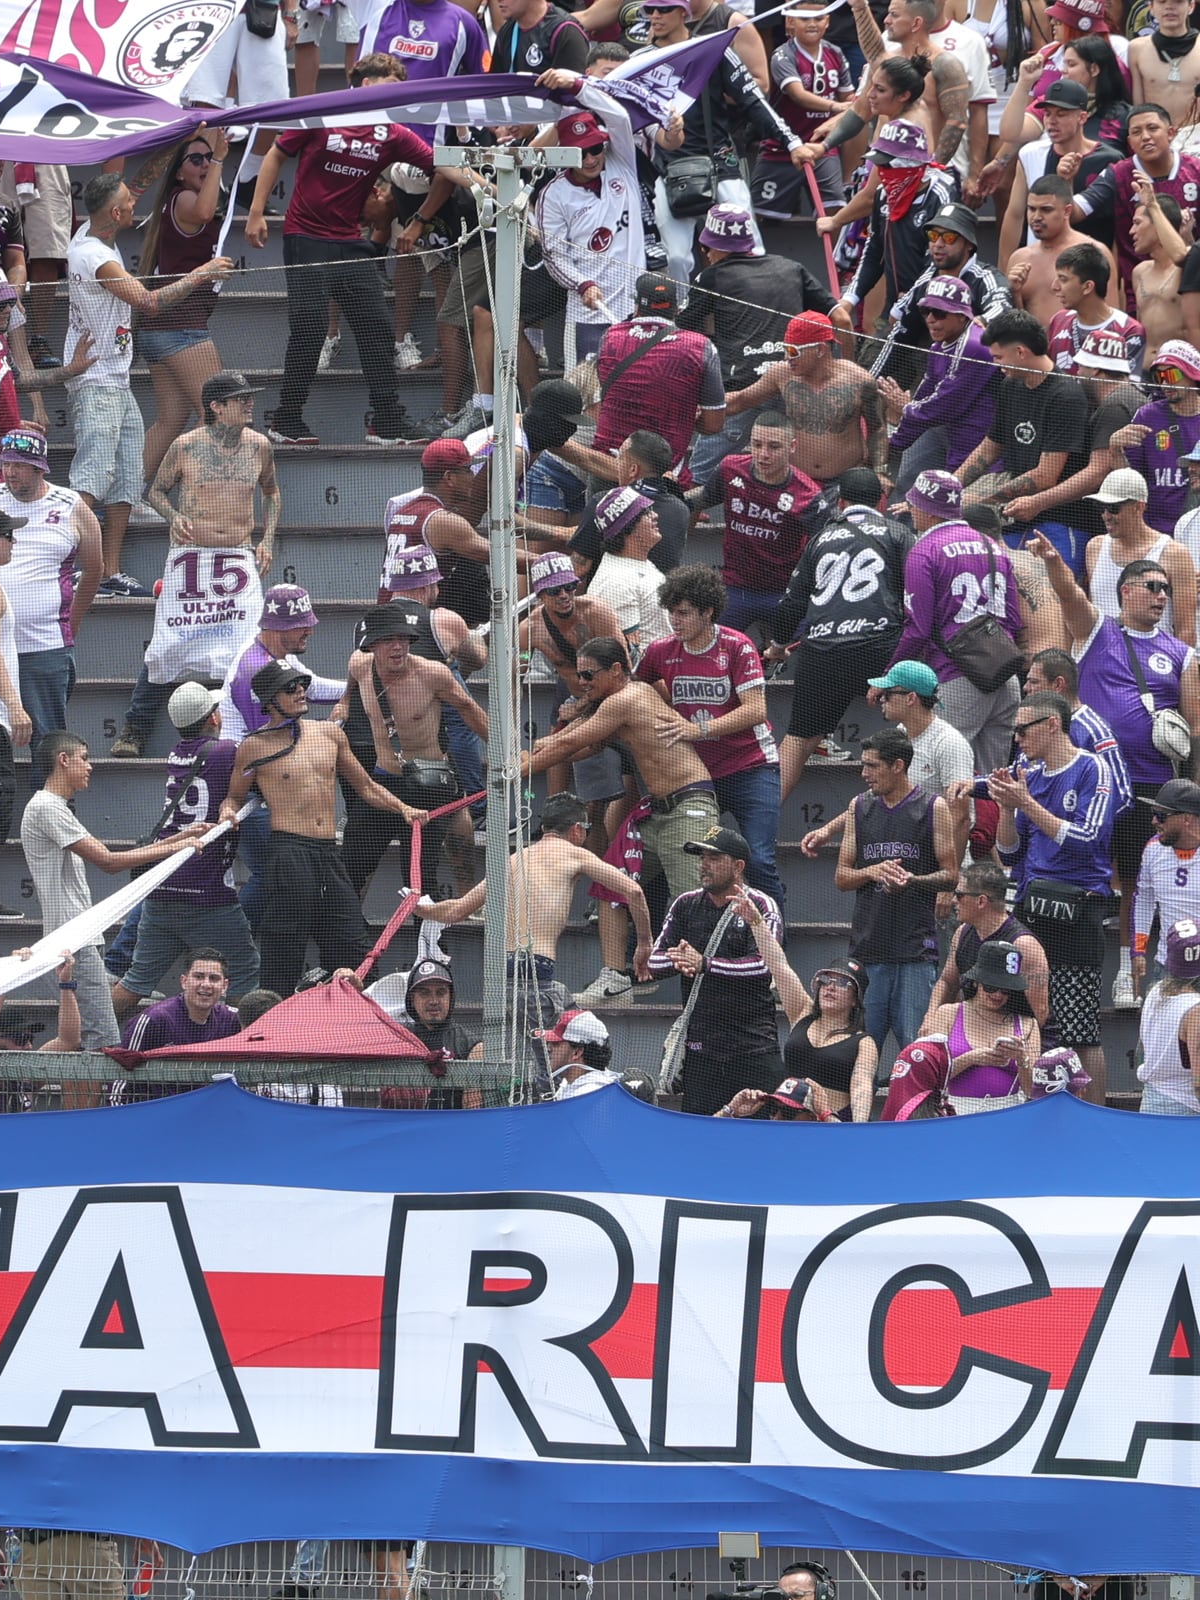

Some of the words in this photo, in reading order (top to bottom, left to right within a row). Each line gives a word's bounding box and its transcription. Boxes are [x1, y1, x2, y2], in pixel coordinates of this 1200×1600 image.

[395, 41, 434, 58] BIMBO
[944, 38, 956, 51] S
[828, 71, 839, 89] S
[374, 125, 387, 141] S
[350, 140, 382, 155] BAC
[324, 162, 370, 178] LIBERTY
[762, 182, 777, 200] S
[1184, 183, 1197, 201] S
[927, 280, 957, 302] GUI-2
[55, 411, 68, 427] 3
[325, 487, 338, 505] 6
[748, 502, 784, 524] BAC
[730, 520, 780, 541] LIBERTY
[173, 552, 250, 600] 15
[284, 566, 296, 583] 6
[810, 548, 886, 606] 98
[183, 599, 236, 614] ULTRA
[167, 615, 191, 628] CON
[194, 609, 246, 625] AGUANTE
[807, 623, 835, 639] LOS
[837, 617, 889, 637] GUI-2
[673, 680, 729, 704] BIMBO
[103, 720, 116, 738] 5
[839, 723, 860, 743] 12
[801, 804, 825, 823] 12
[1173, 867, 1188, 886] S
[21, 879, 34, 897] 5
[1030, 895, 1077, 921] VLTN
[375, 1189, 1200, 1482] RICA
[901, 1569, 926, 1591] 16
